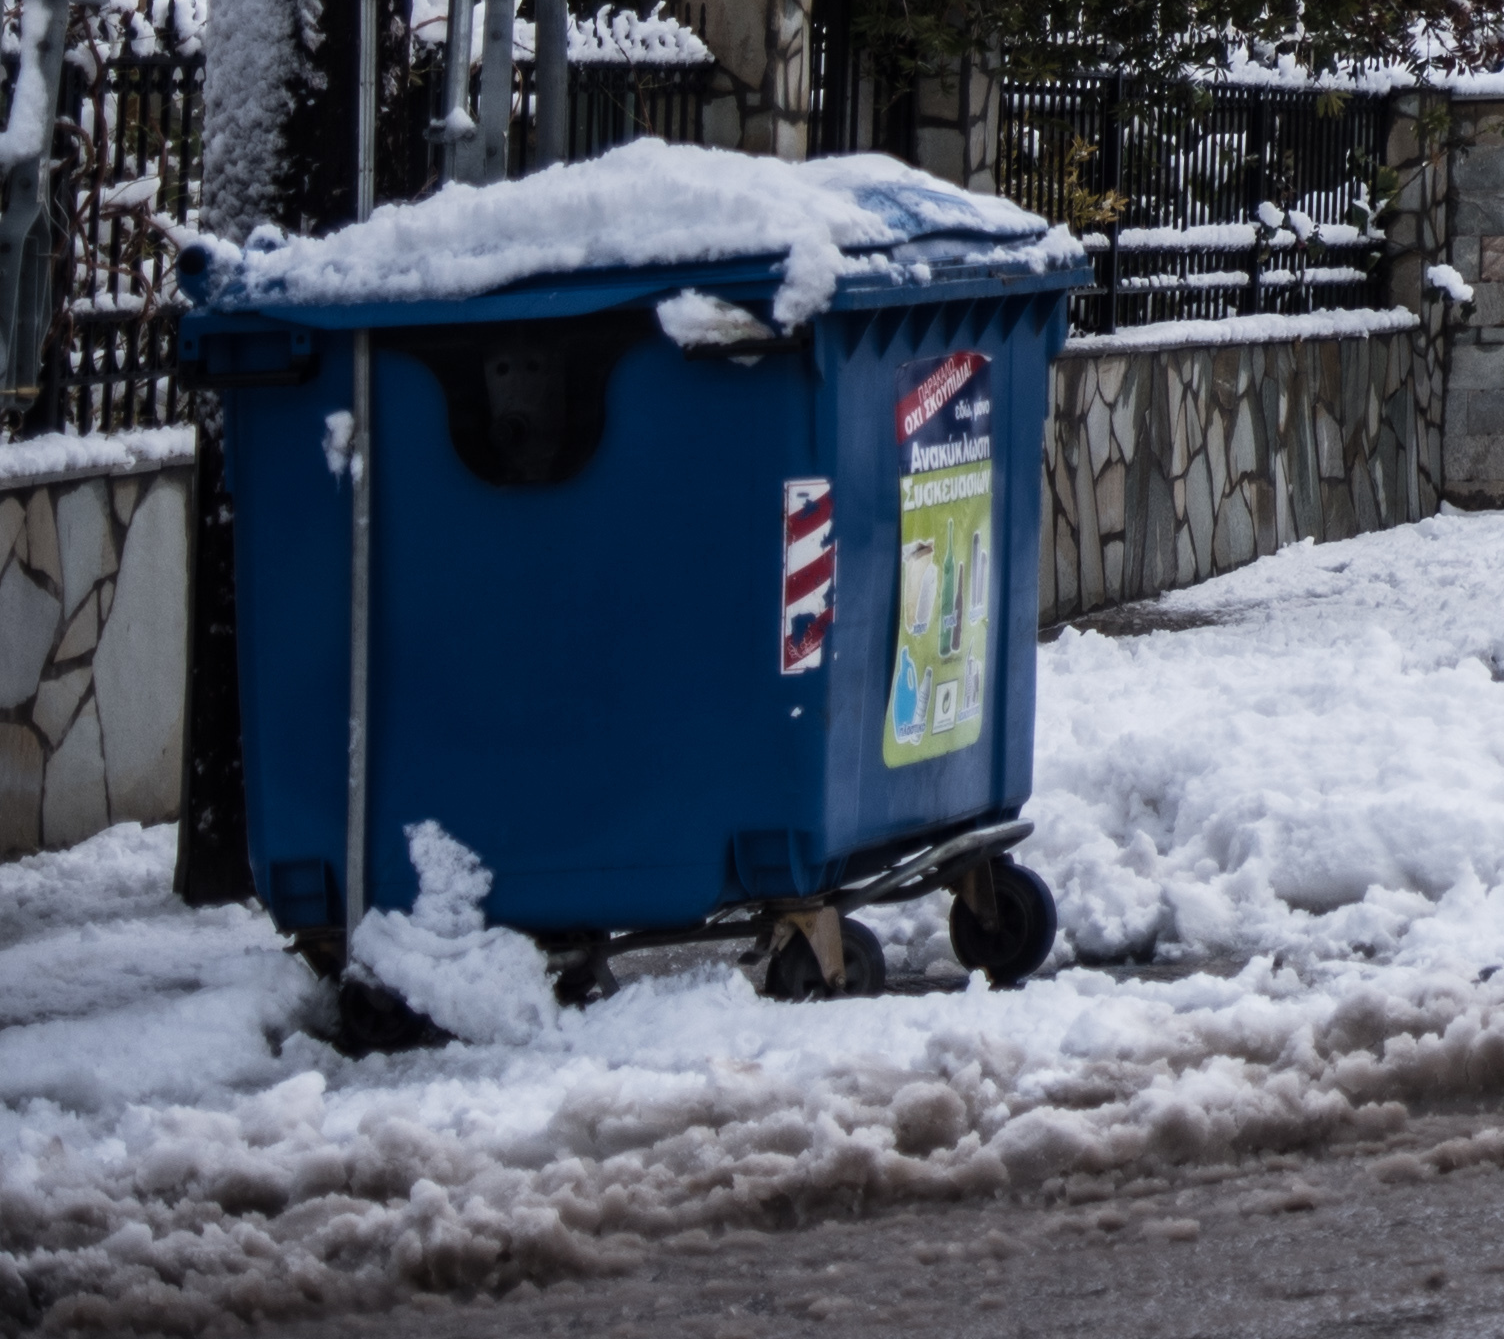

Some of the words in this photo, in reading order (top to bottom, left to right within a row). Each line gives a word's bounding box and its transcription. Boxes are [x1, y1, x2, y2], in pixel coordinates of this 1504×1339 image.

[904, 408, 924, 436] ΟΧΙ
[924, 358, 973, 420] ΣΚΟΥΠΙΔΙΑ!
[917, 357, 957, 404] ΠΑΡΑΚΑΛΩ
[910, 432, 990, 474] Ανακύκλωση
[902, 462, 992, 512] Συσκευασιών
